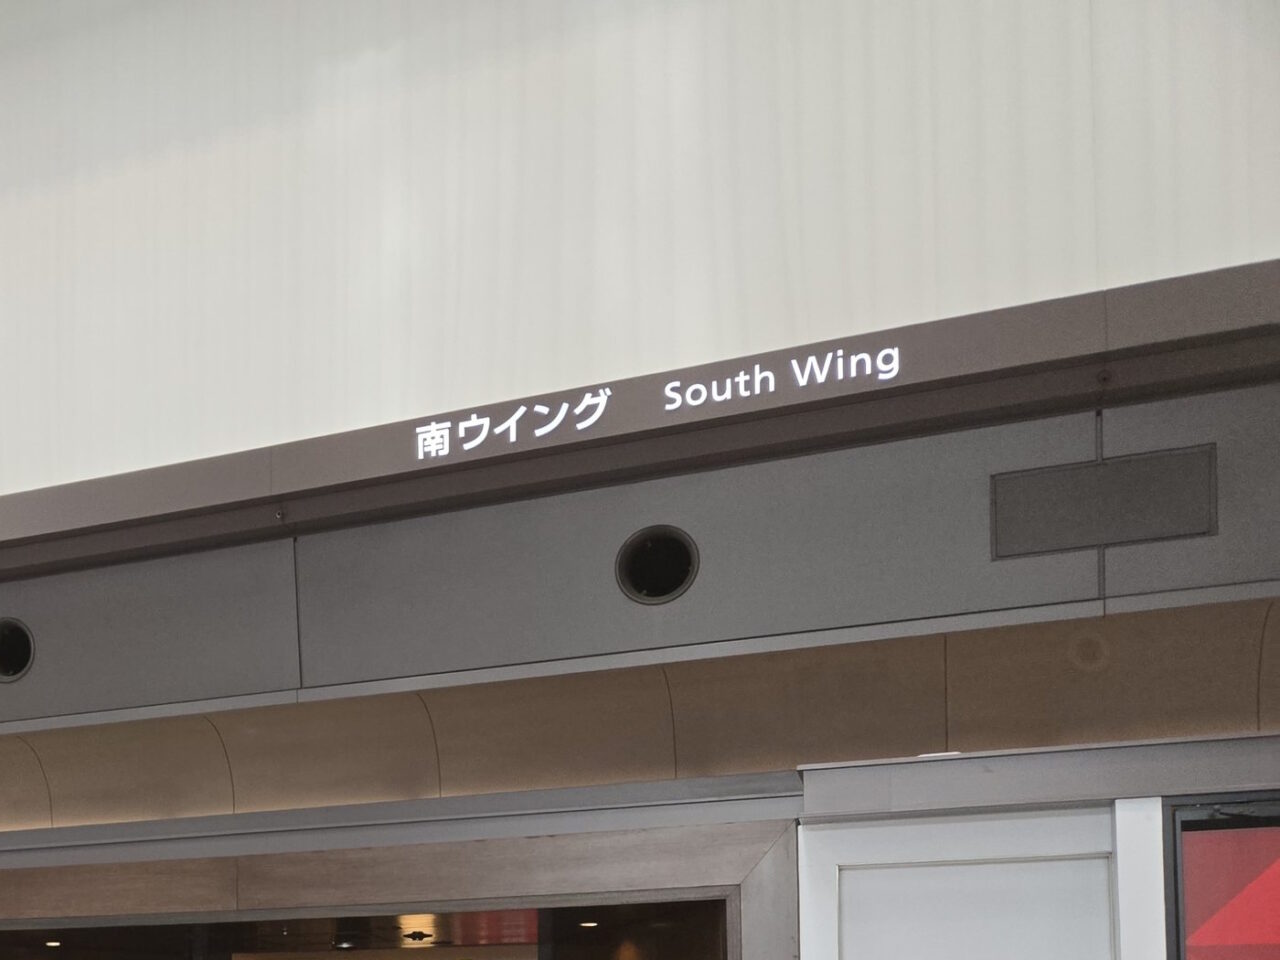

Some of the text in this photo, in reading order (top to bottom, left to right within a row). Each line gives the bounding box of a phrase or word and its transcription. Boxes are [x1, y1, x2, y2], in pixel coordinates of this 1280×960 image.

[416, 346, 900, 459] 南ウイング South Wing
